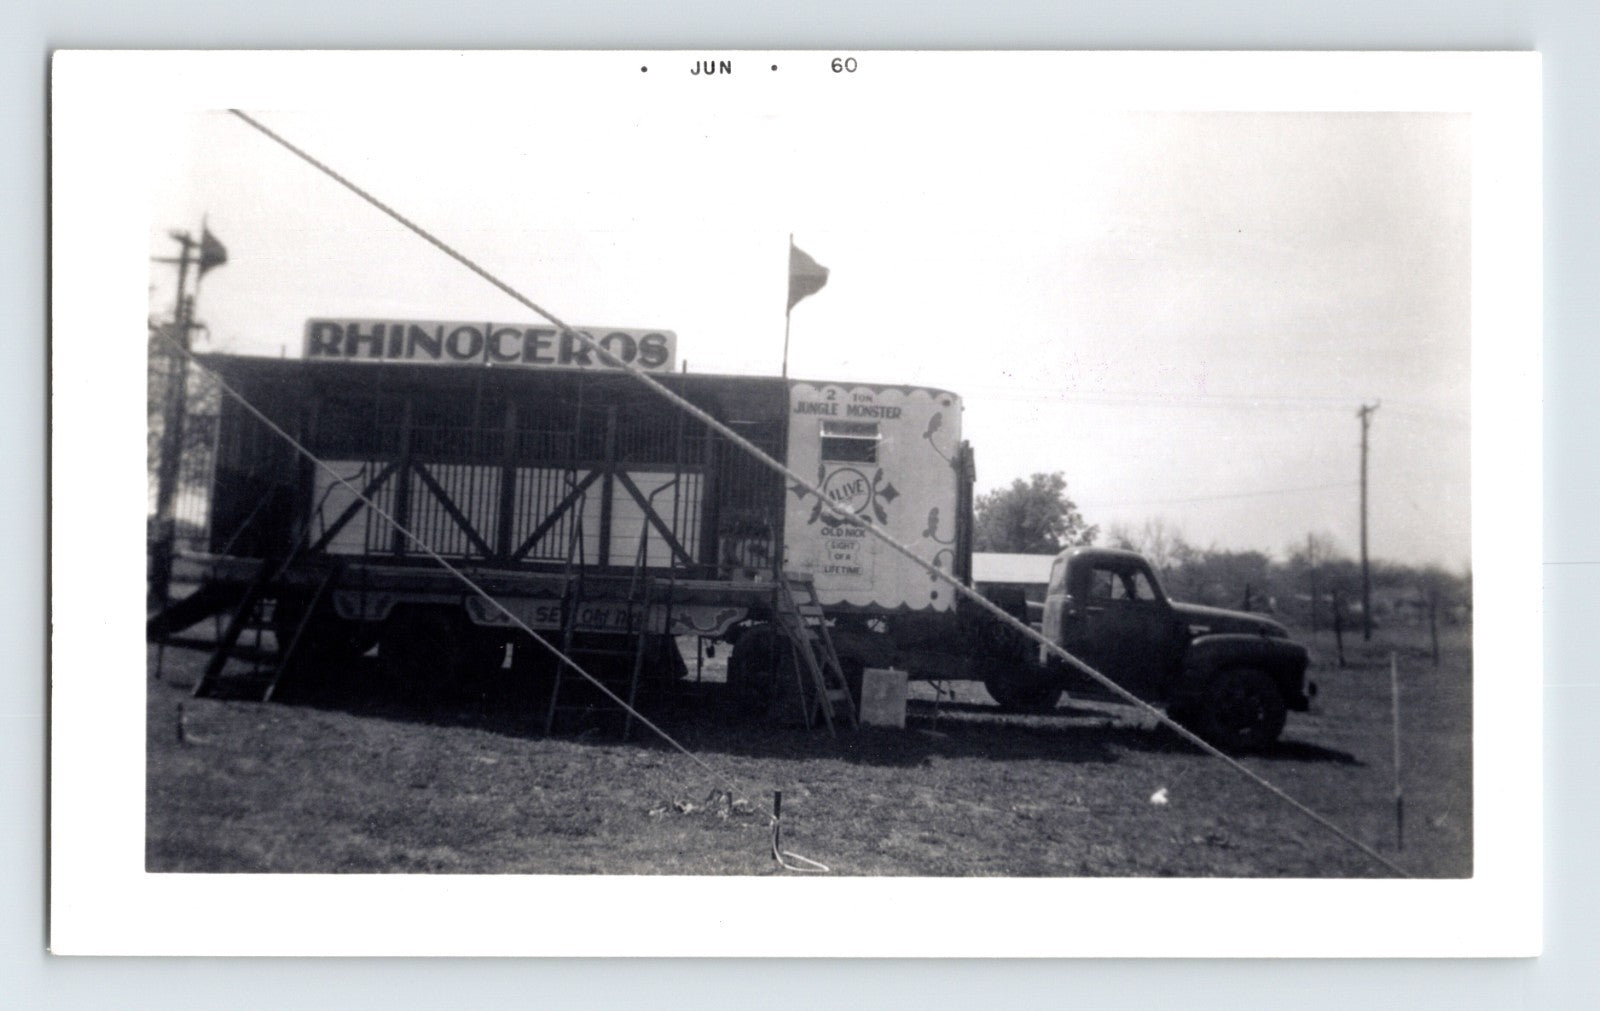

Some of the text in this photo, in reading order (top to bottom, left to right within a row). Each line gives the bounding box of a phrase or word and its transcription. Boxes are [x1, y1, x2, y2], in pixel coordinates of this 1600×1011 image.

[308, 321, 671, 369] RHINOCEROS
[826, 389, 873, 402] 2 TON
[793, 401, 902, 419] JUNGLE MONSTER
[829, 479, 864, 501] ALIVE
[821, 527, 866, 538] OLD NICK
[824, 566, 860, 575] LIFETIME
